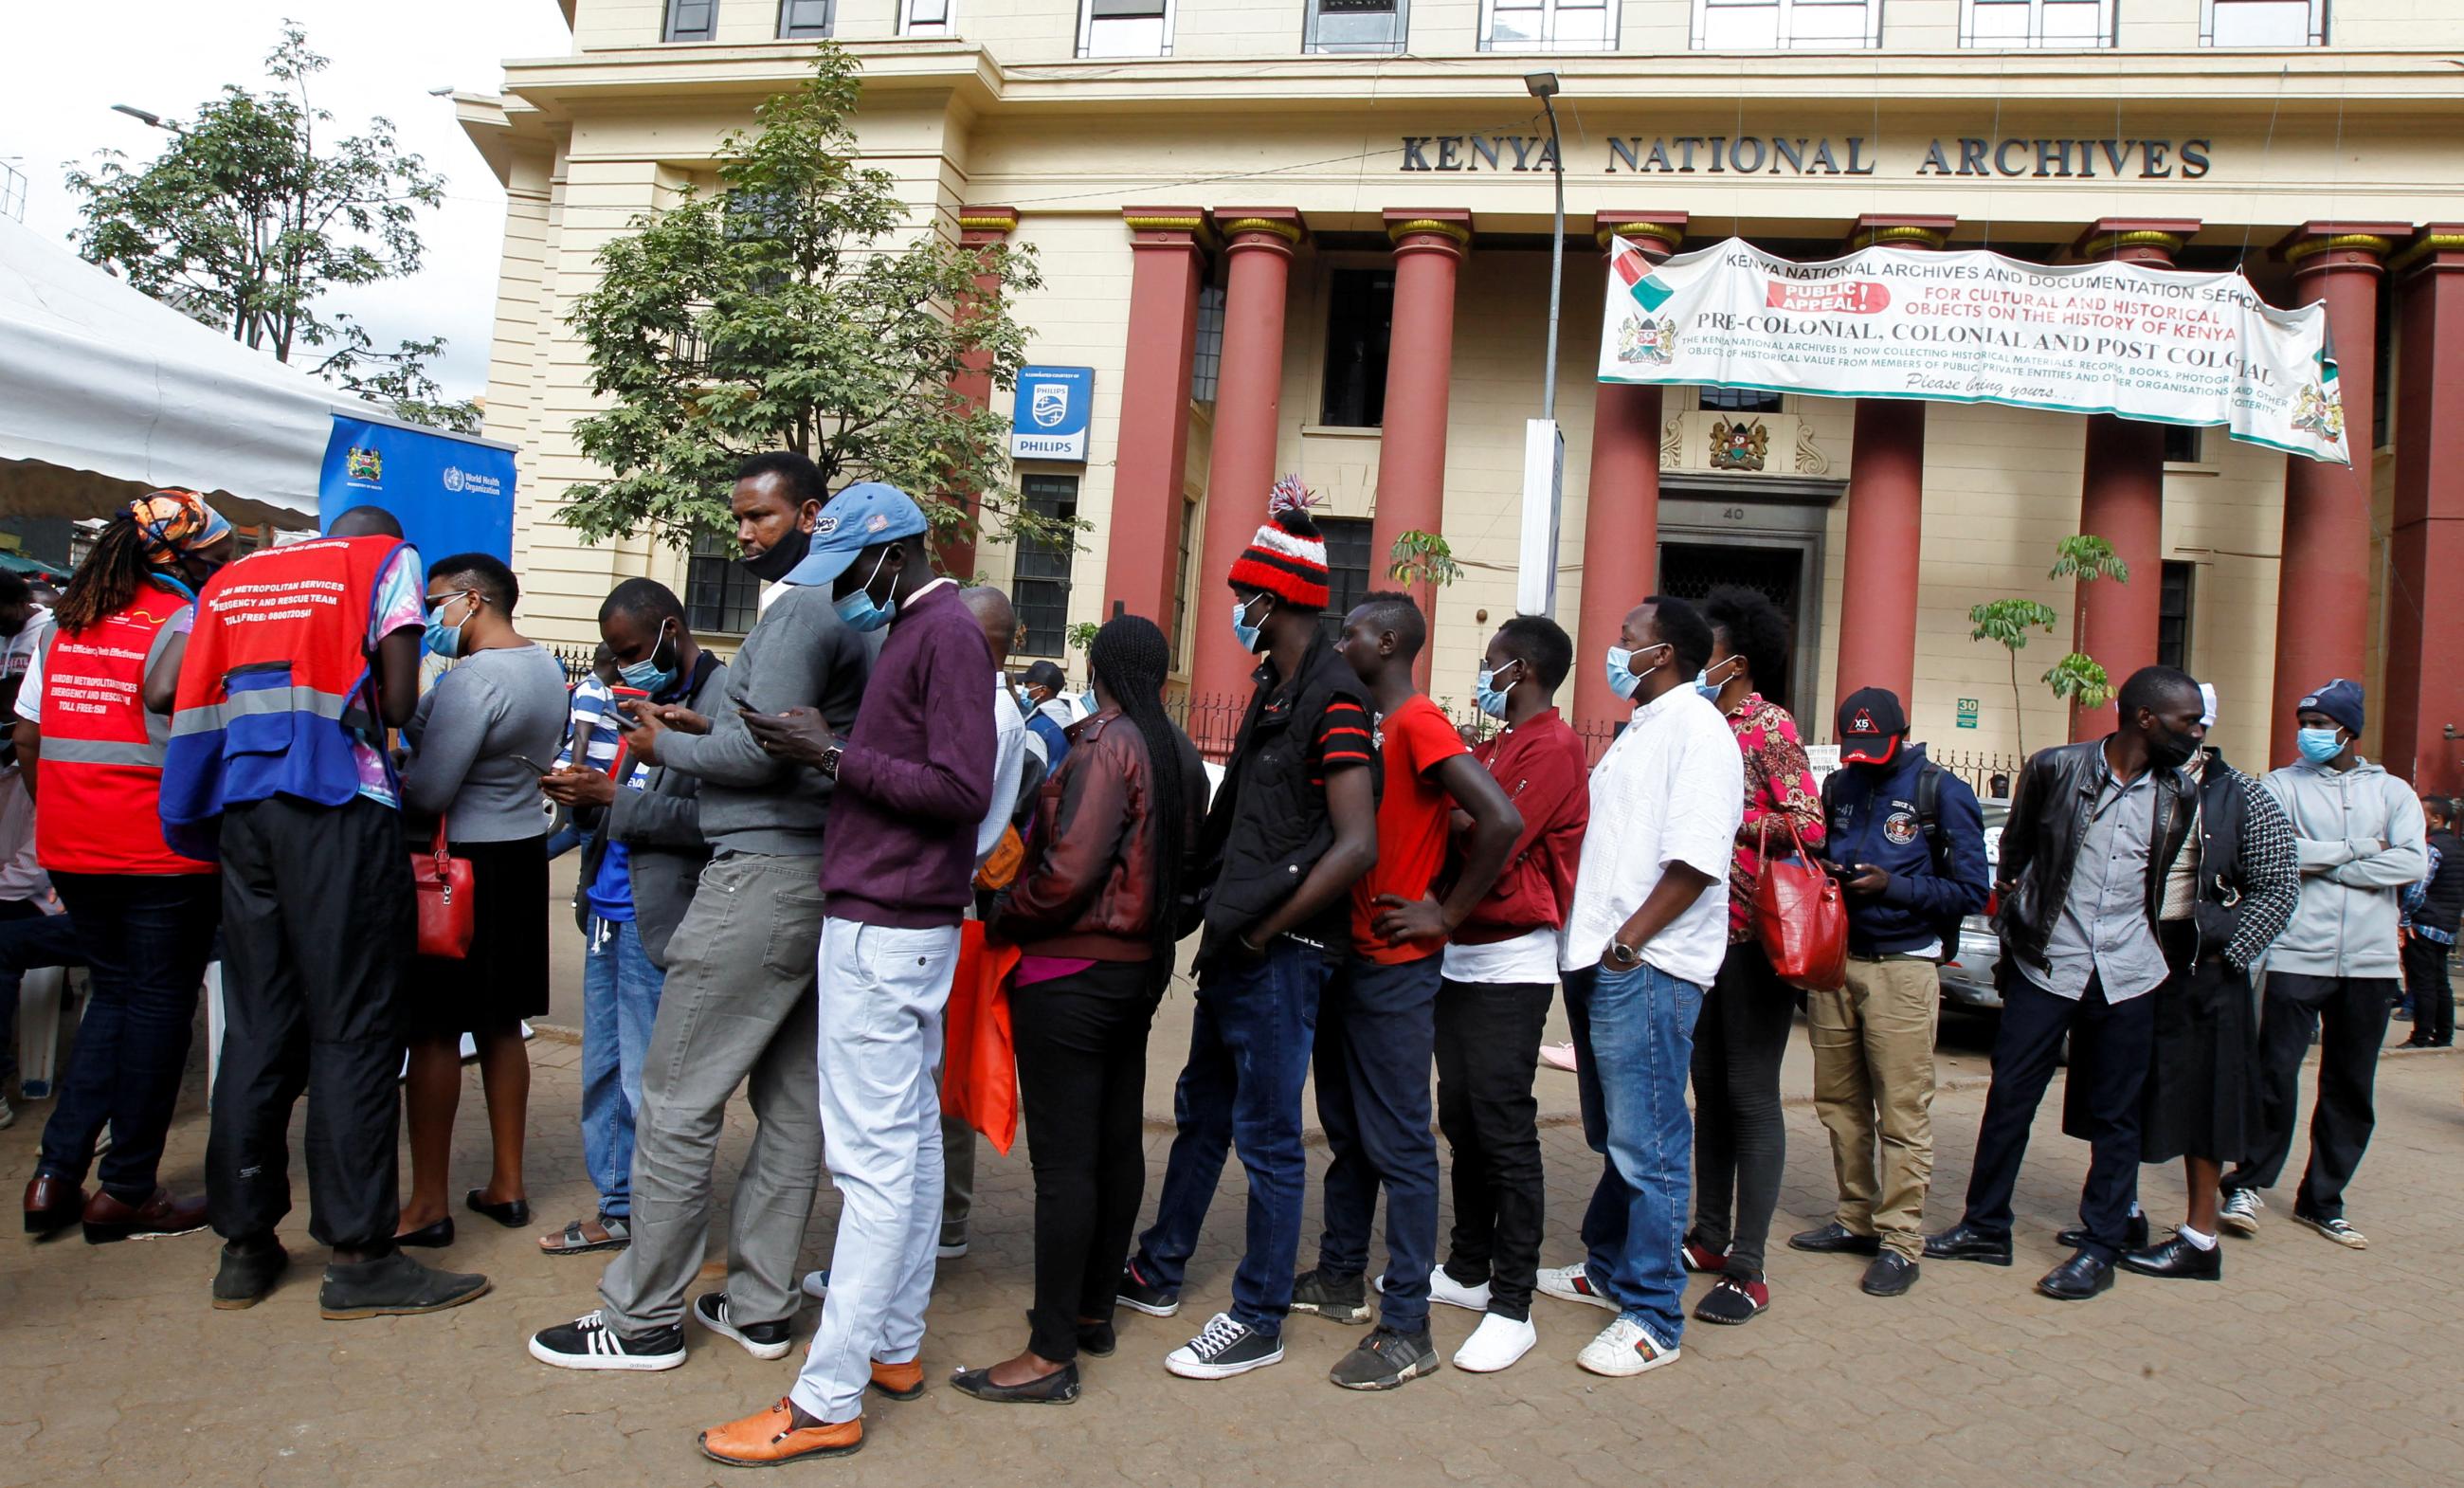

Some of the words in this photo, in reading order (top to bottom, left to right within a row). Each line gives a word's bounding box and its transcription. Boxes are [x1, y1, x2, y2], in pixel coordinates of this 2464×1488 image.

[1400, 136, 1565, 172] KENYA
[1605, 136, 1875, 174] NATIONAL
[1916, 137, 2211, 178] ARCHIVES
[1726, 253, 1781, 277] KENYA
[1785, 262, 1876, 281] NATIONAL
[1881, 263, 1980, 280] ARCHIVES
[1983, 267, 2022, 284] AND
[2028, 275, 2196, 299] DOCUMENTATION
[1785, 281, 1857, 298] PUBLIC
[1924, 286, 1961, 300] FOR
[1968, 288, 2059, 309] CULTURAL
[2066, 297, 2107, 311] AND
[2113, 299, 2220, 325] HISTORICAL
[1905, 301, 1982, 318] OBJECTS
[1987, 305, 2016, 322] ON
[2021, 308, 2056, 323] THE
[2062, 312, 2135, 331] HISTORY
[2142, 320, 2167, 336] OF
[2173, 323, 2237, 342] KENYA
[1696, 311, 1885, 342] PRE-COLONIAL,
[1891, 323, 2028, 349] COLONIAL
[2033, 333, 2090, 353] AND
[2095, 337, 2161, 360] POST
[1681, 335, 1699, 345] THE
[1731, 336, 1784, 350] NATIONAL
[1786, 341, 1837, 354] ARCHIVES
[1839, 344, 1848, 354] IS
[1853, 347, 1880, 355] NOW
[1883, 347, 1948, 358] COLLECTING
[1951, 350, 2010, 364] HISTORICAL
[2256, 389, 2289, 408] OTHER
[1740, 351, 1801, 363] HISTORICAL
[1803, 355, 1836, 366] VALUE
[1838, 357, 1868, 367] FROM
[1871, 358, 1922, 369] MEMBERS
[1925, 360, 1939, 369] OF
[1983, 363, 2024, 376] PRIVATE
[2027, 367, 2073, 380] ENTITIES
[2075, 372, 2099, 383] AND
[2135, 379, 2229, 396] ORGANISATIONS
[1905, 372, 1961, 390] Please
[1966, 376, 2005, 396] bring
[1020, 441, 1073, 453] PHILIPS
[464, 472, 481, 484] World
[482, 474, 500, 487] Health
[464, 481, 500, 496] Organization
[1723, 508, 1744, 520] 40
[234, 581, 299, 594] METROPOLITAN
[299, 580, 345, 591] SERVICES
[258, 596, 277, 608] AND
[278, 594, 309, 607] RESCUE
[310, 593, 337, 606] TEAM
[59, 701, 76, 712] TOLL
[1959, 699, 1978, 712] 30
[1855, 718, 1869, 729] X5
